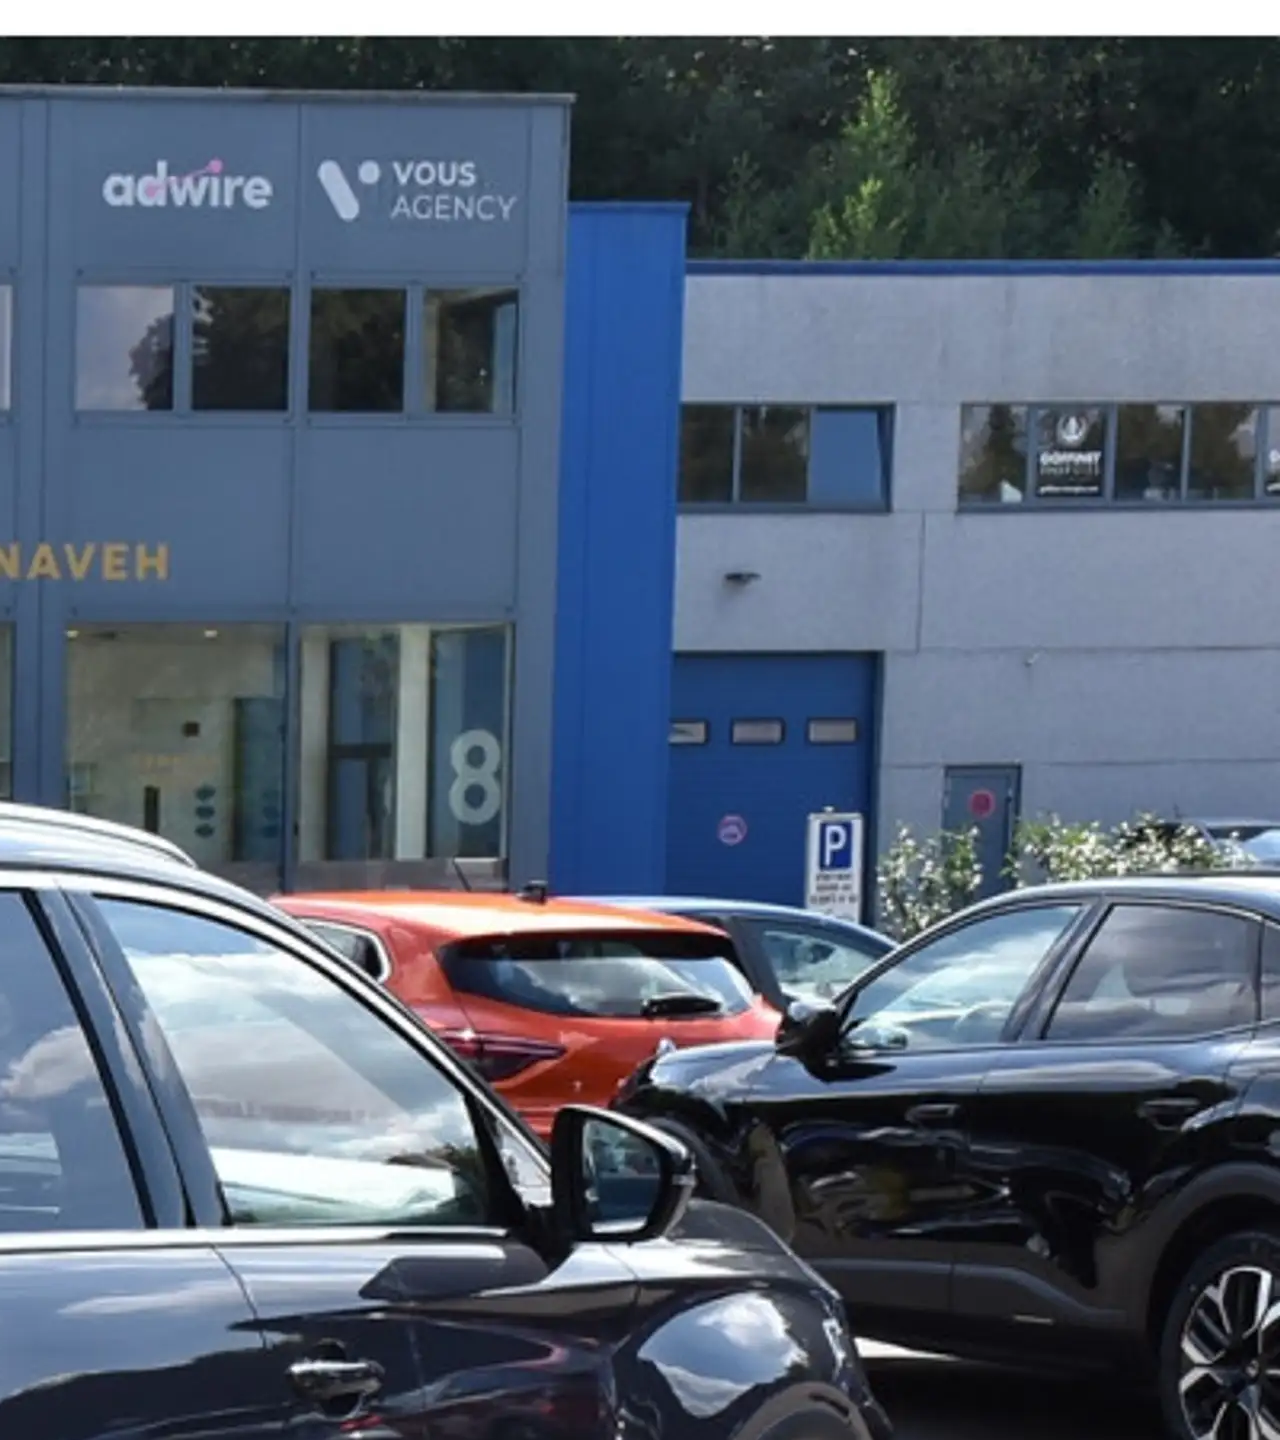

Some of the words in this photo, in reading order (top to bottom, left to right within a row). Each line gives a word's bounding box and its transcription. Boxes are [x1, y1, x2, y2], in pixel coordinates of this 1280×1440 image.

[103, 158, 273, 209] adwire
[391, 161, 476, 188] VOUS
[390, 194, 518, 221] AGENCY
[449, 729, 501, 825] 8
[825, 825, 847, 866] P
